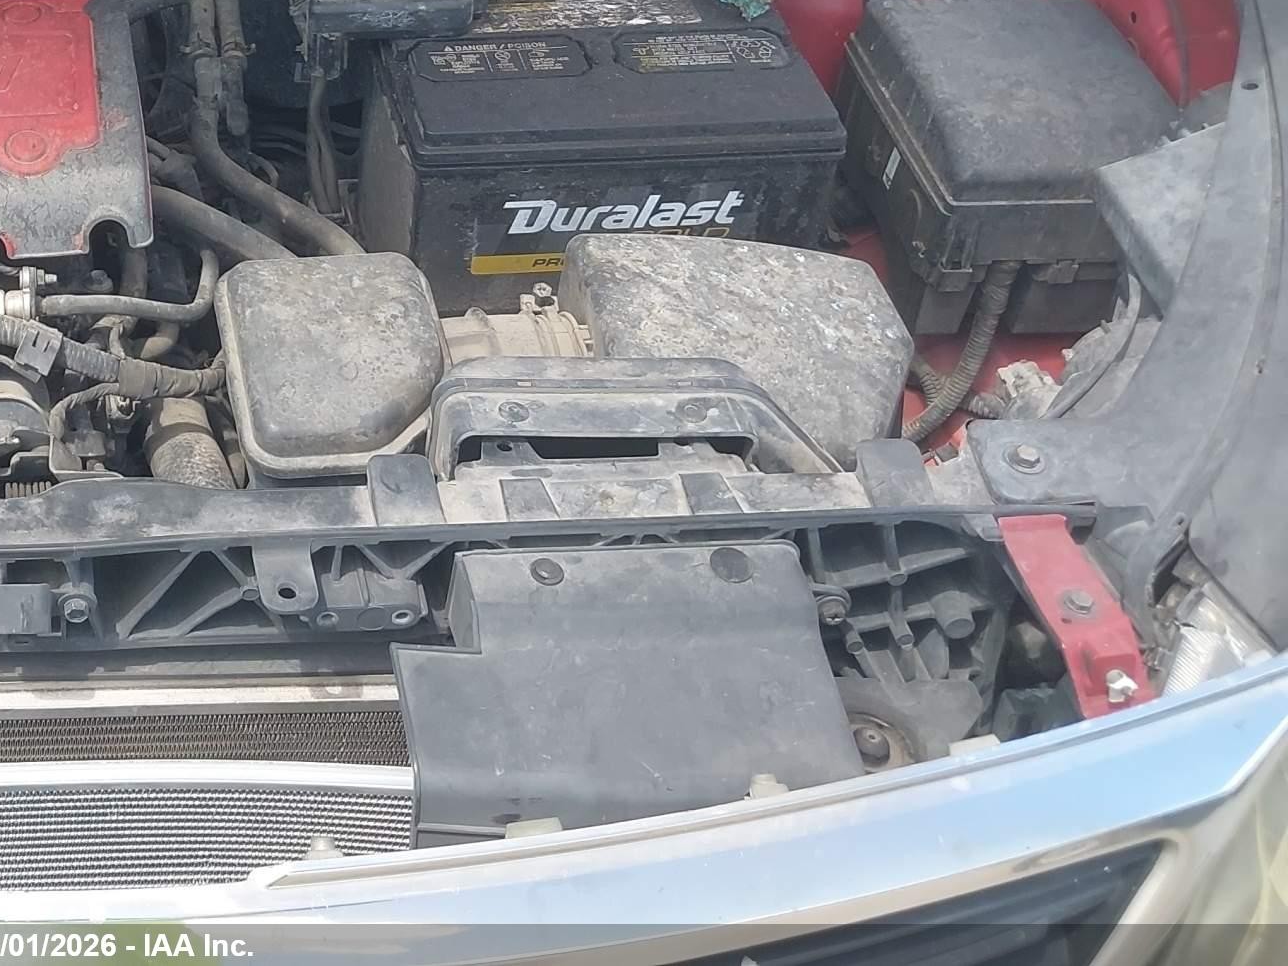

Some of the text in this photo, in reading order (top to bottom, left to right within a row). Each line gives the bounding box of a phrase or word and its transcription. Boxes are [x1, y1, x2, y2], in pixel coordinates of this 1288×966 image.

[455, 43, 497, 52] DANGER
[507, 41, 547, 50] POISON
[503, 190, 745, 234] Duralast
